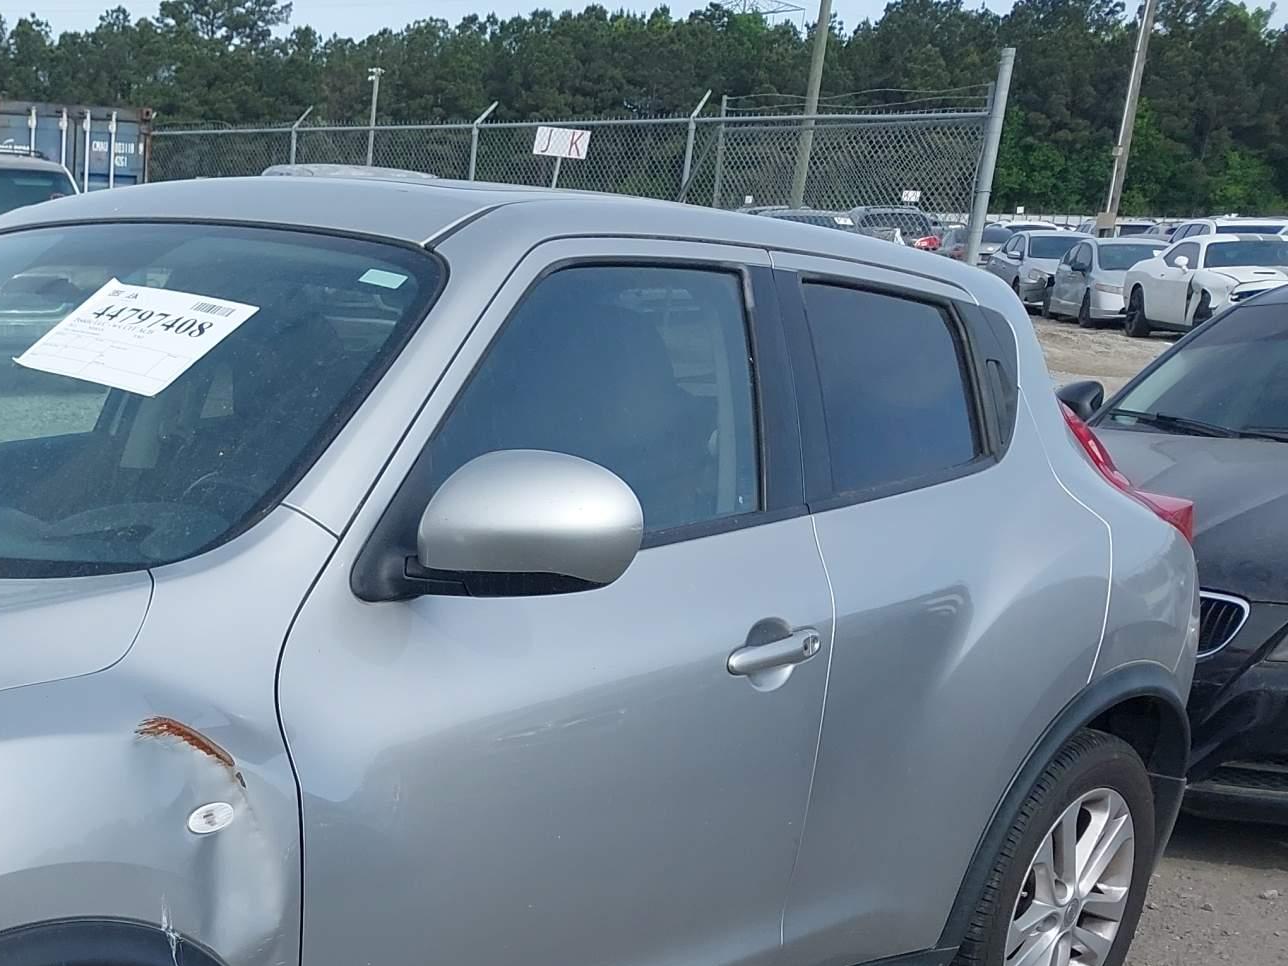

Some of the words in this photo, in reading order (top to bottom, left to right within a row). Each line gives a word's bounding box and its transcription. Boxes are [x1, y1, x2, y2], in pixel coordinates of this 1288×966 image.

[540, 129, 554, 153] J
[568, 131, 585, 157] K
[92, 304, 214, 338] 44797408
